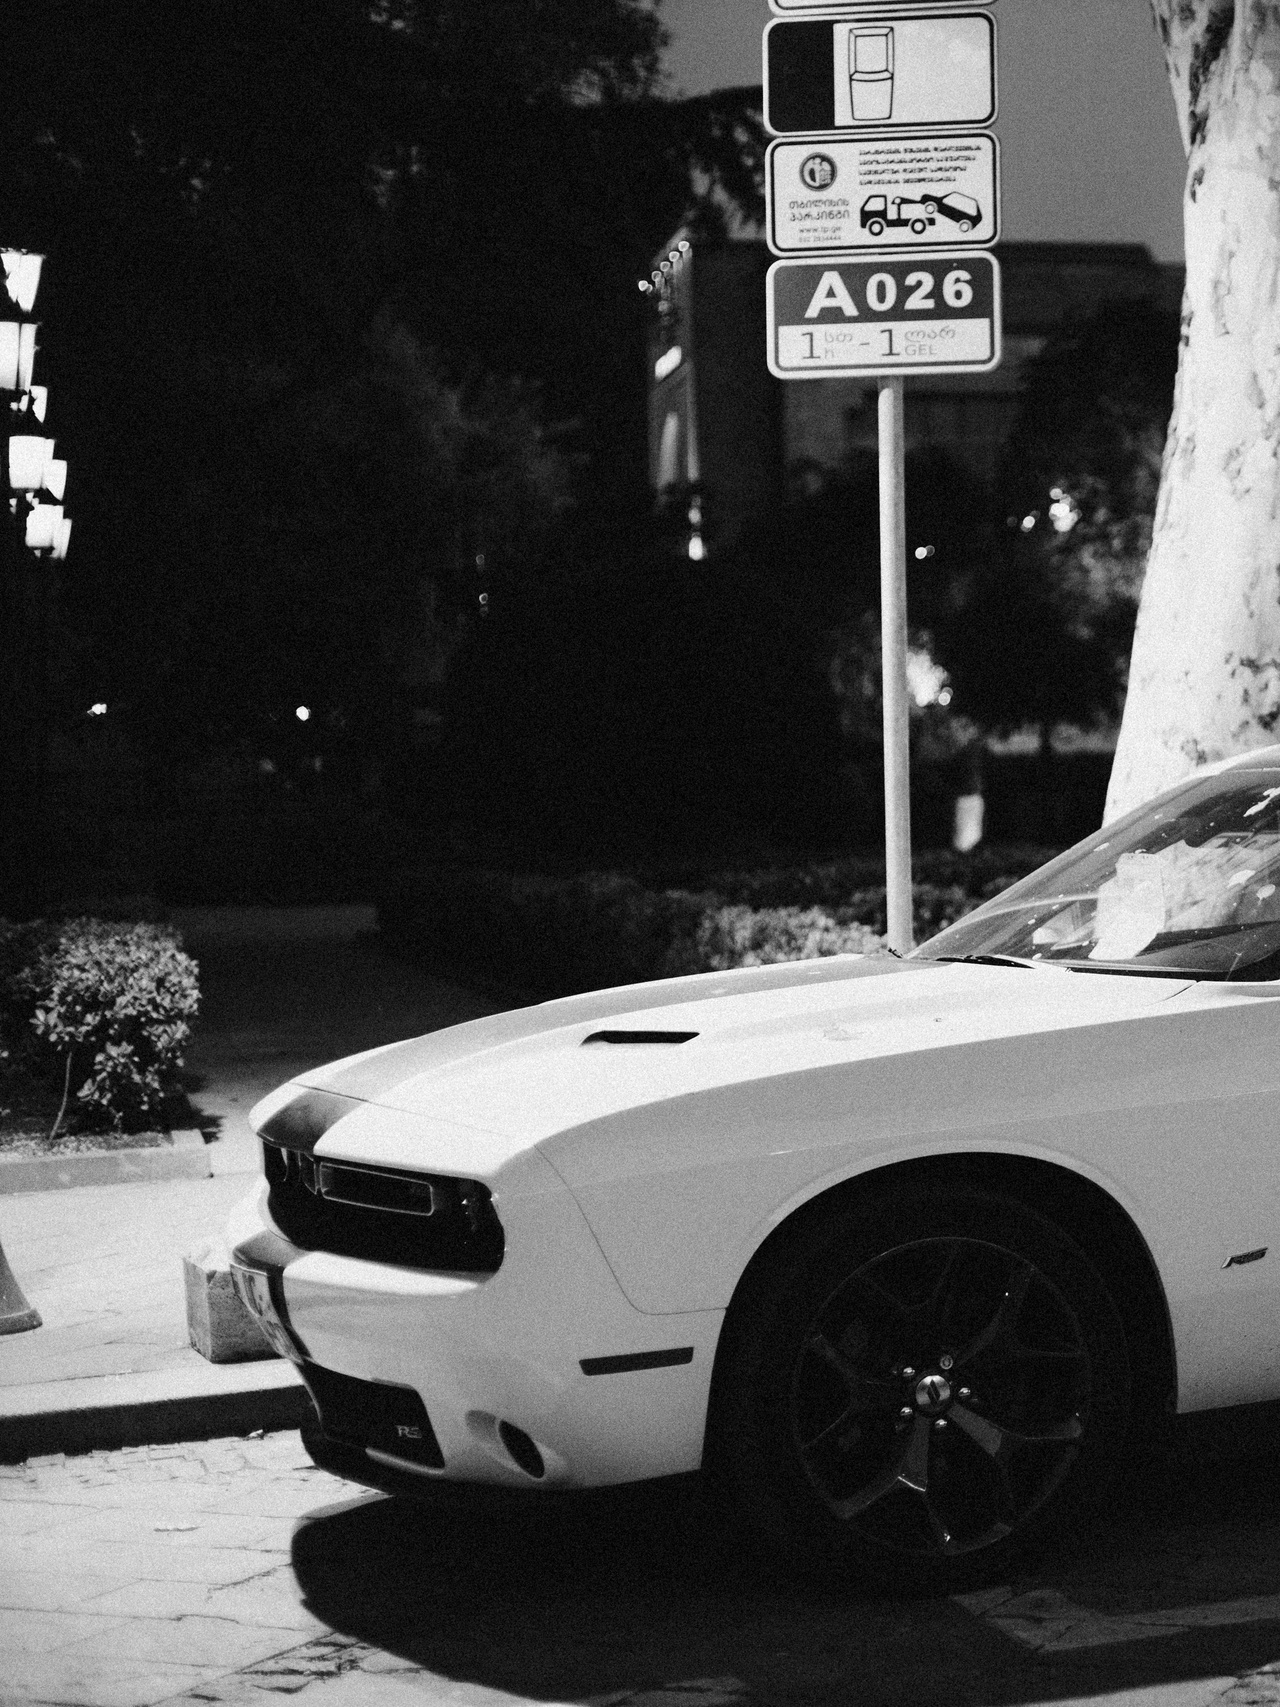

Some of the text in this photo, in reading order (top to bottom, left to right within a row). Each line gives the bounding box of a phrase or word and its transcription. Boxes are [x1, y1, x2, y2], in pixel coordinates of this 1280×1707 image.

[804, 269, 974, 318] A026
[801, 332, 820, 359] 1
[880, 329, 901, 356] 1
[904, 343, 938, 356] GEL
